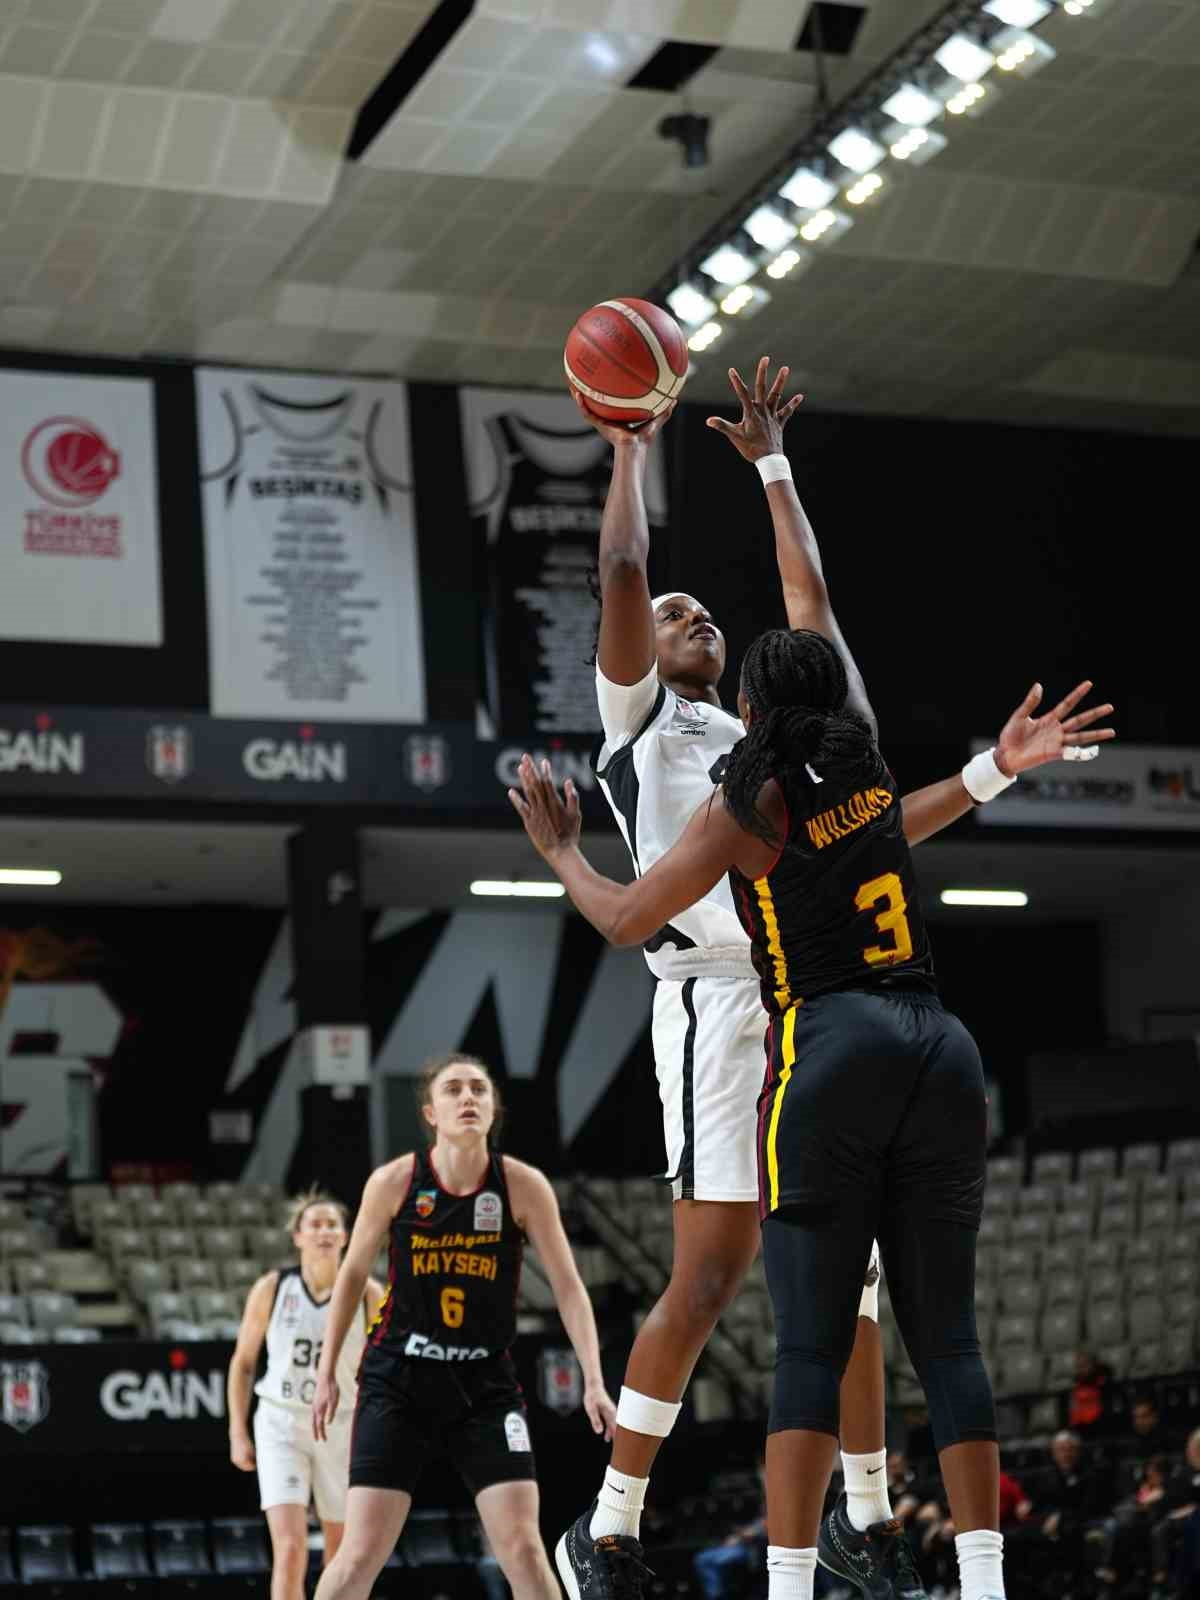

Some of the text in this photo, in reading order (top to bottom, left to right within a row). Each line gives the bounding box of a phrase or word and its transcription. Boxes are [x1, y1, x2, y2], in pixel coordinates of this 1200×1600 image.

[804, 786, 893, 850] WILLIAMS
[854, 871, 914, 968] 3
[439, 1287, 466, 1329] 6
